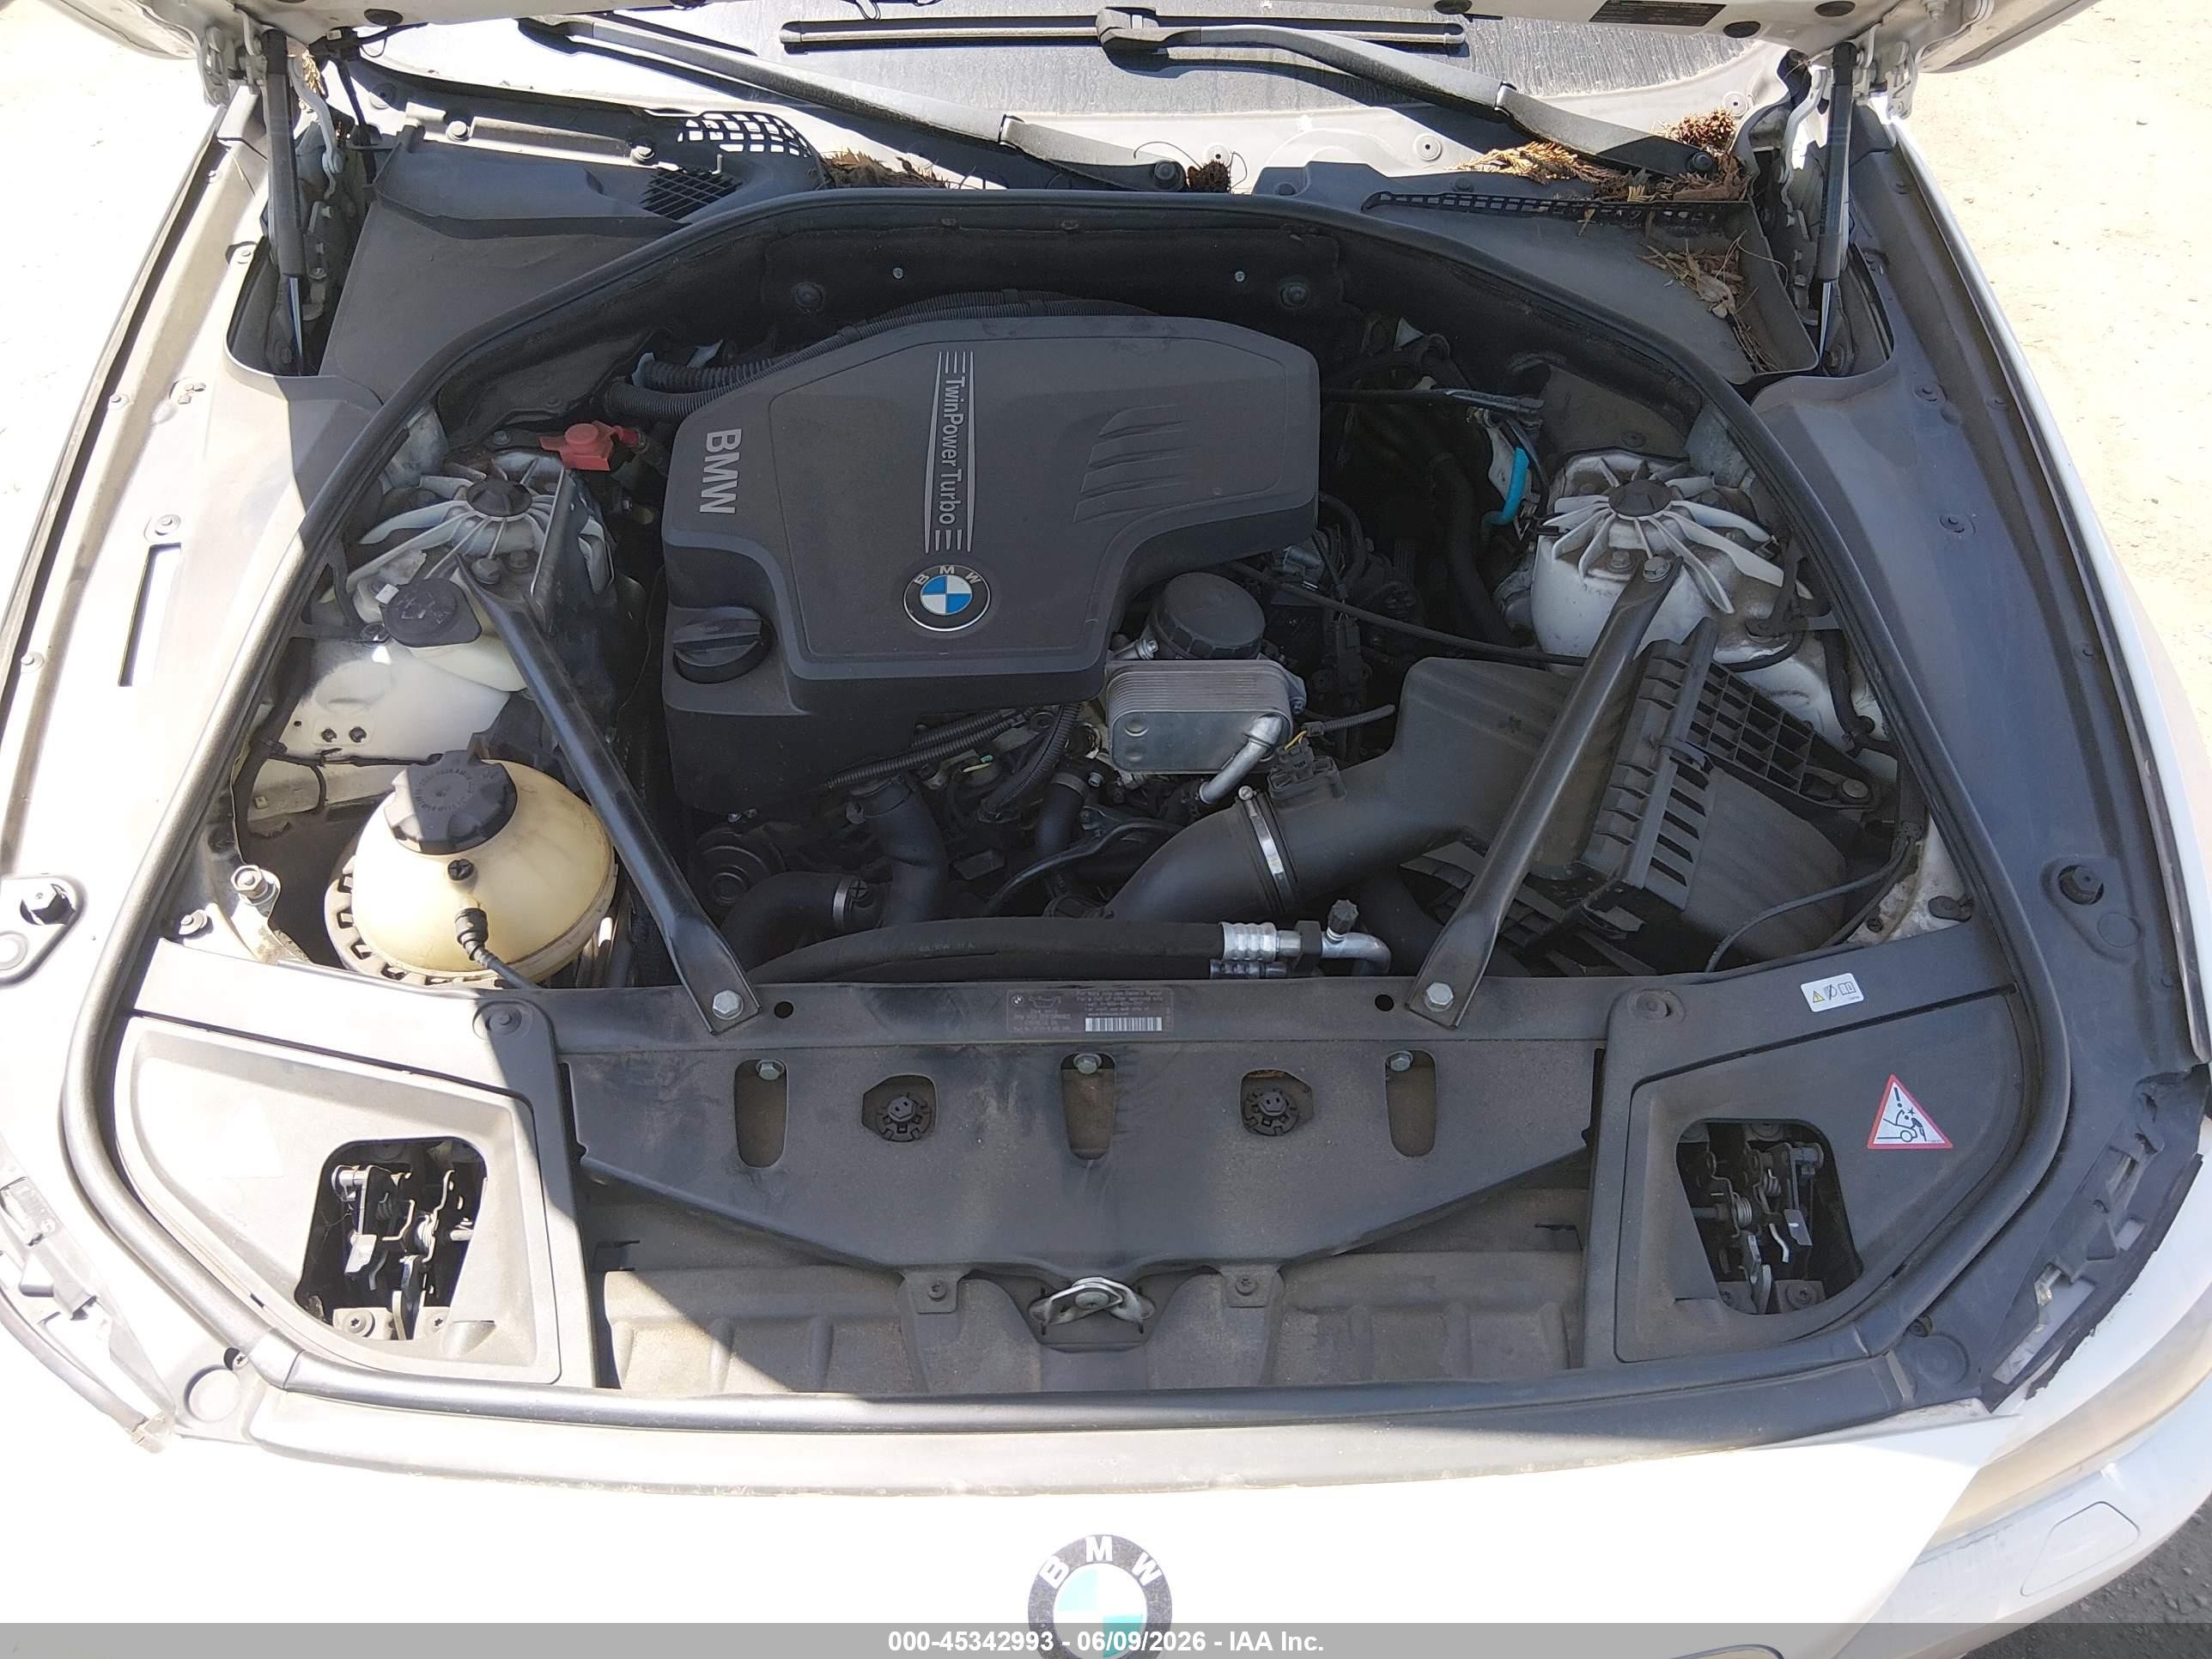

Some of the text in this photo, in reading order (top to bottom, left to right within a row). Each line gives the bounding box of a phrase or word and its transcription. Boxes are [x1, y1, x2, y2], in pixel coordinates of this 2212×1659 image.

[699, 428, 742, 514] BMW
[939, 376, 966, 525] TwinPower Turbo
[914, 566, 981, 586] BMW
[1038, 1535, 1163, 1589] BMW
